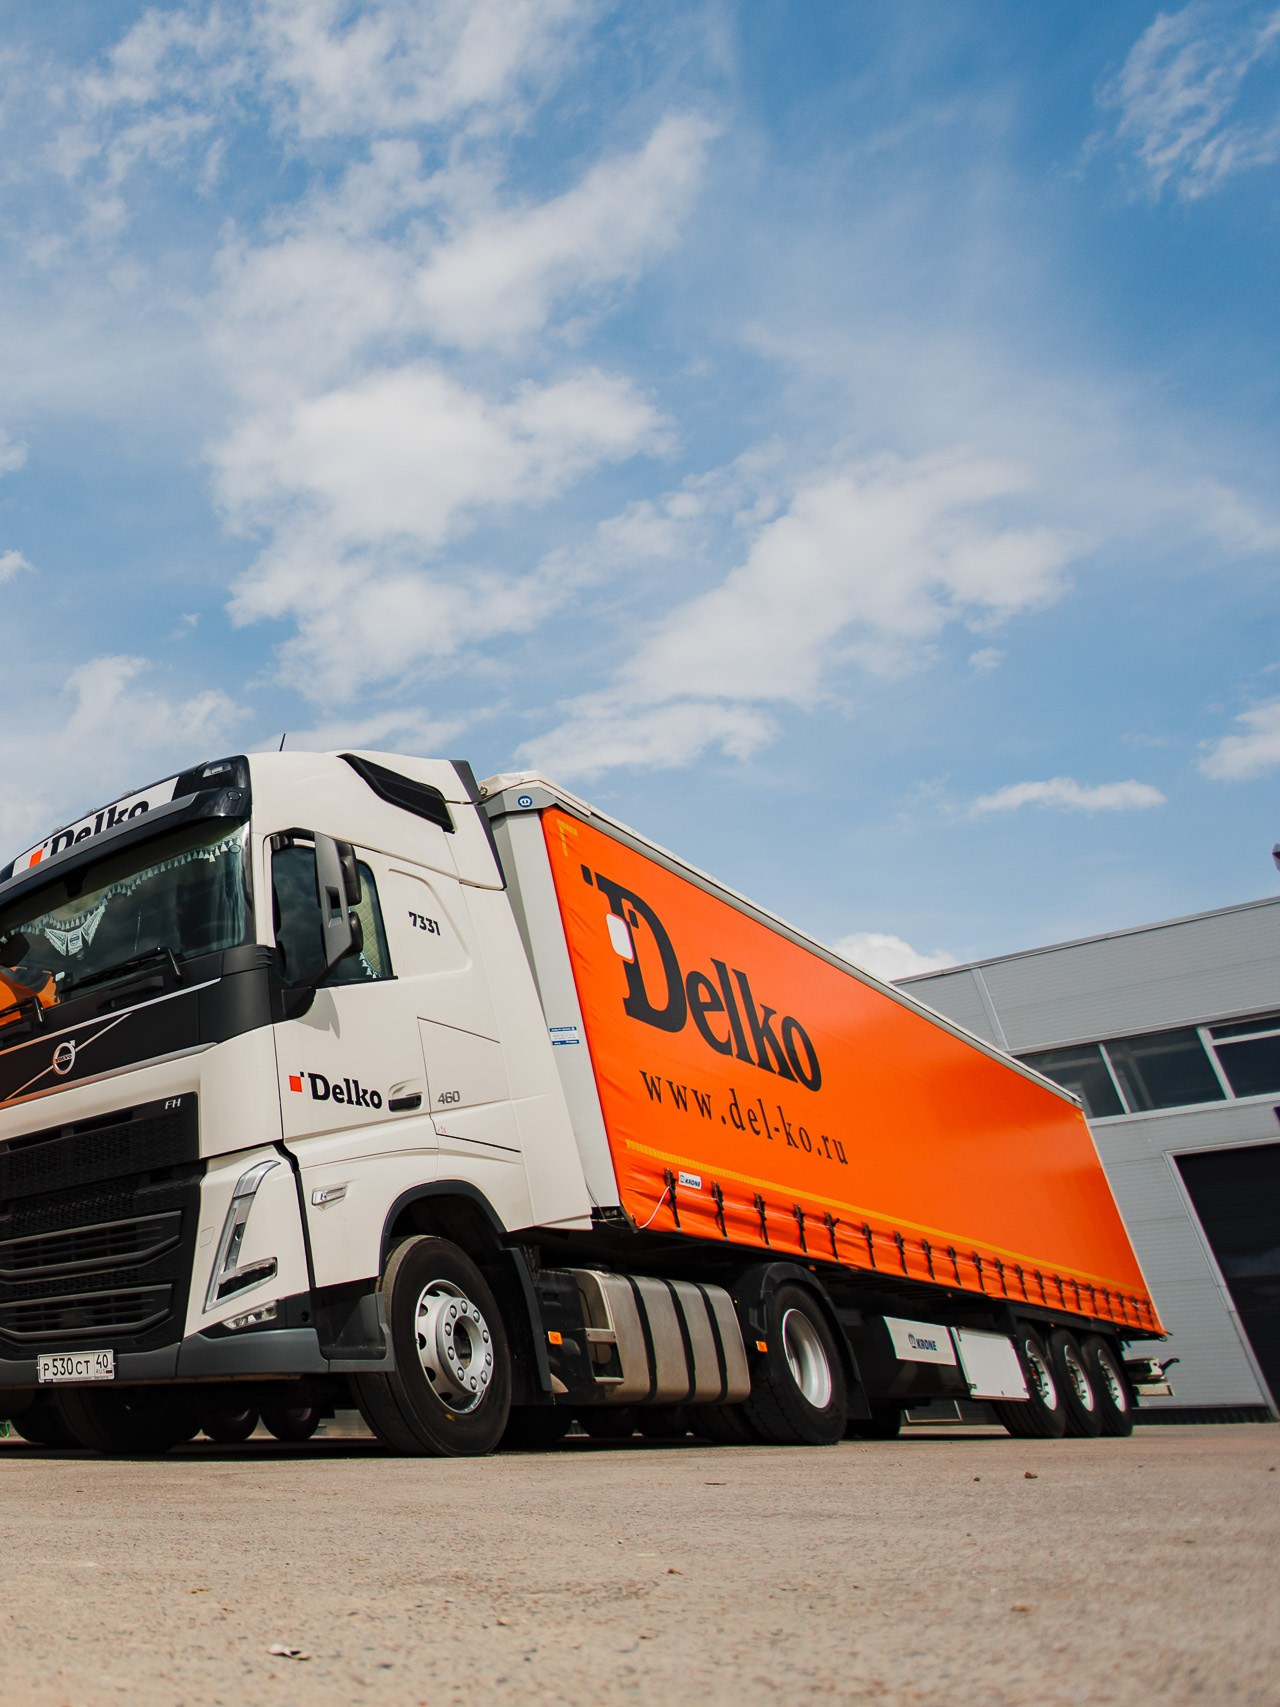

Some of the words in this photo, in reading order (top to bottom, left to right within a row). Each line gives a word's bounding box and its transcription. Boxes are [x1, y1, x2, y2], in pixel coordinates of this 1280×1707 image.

[50, 800, 150, 857] Delko
[408, 911, 441, 936] 7331
[584, 867, 823, 1093] Delko
[164, 1098, 182, 1110] FH
[307, 1072, 383, 1110] Delko
[437, 1090, 461, 1105] 460
[639, 1070, 849, 1165] www.del-ko.ru
[96, 1354, 109, 1369] 40
